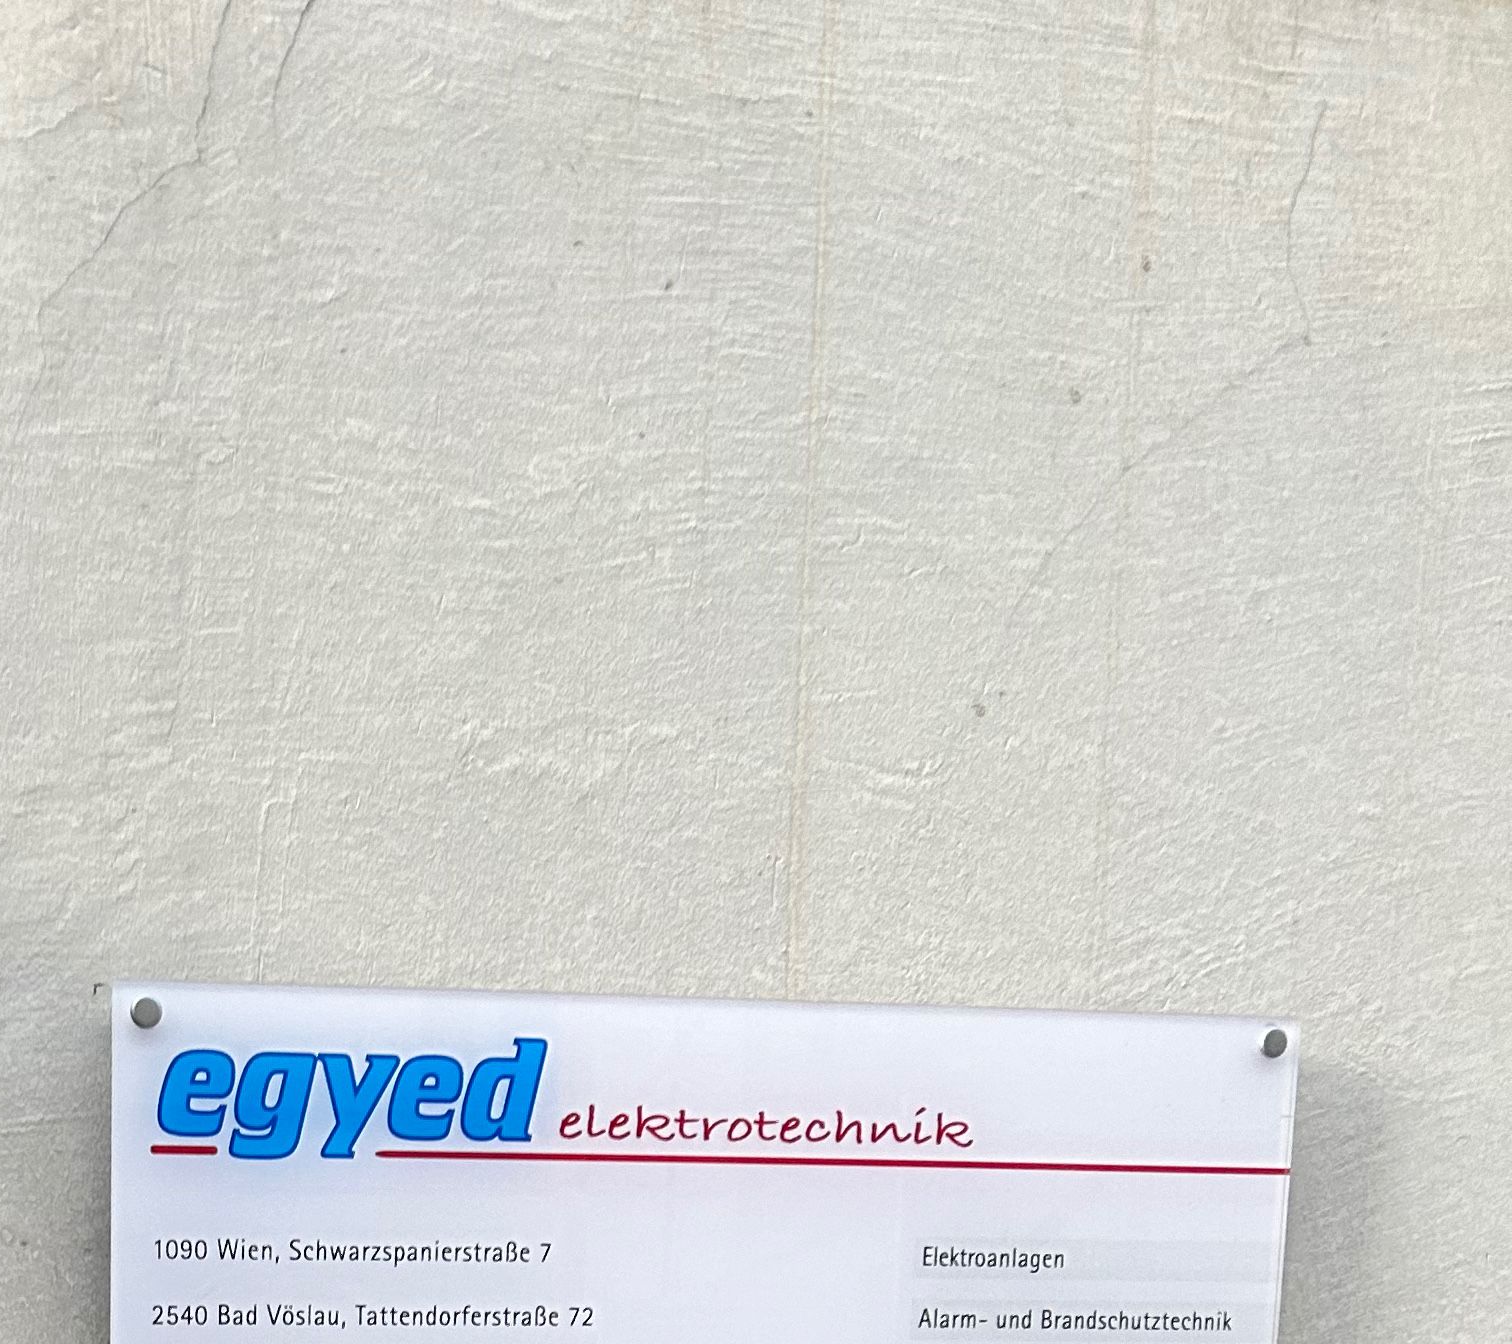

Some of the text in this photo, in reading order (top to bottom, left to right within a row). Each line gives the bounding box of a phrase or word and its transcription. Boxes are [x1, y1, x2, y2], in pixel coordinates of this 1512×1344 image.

[155, 1036, 974, 1160] egyed elektrotechnik
[154, 1238, 552, 1268] 1090 Wien, Schwarzspanierstraße 7
[922, 1246, 1065, 1274] Elektroanlagen
[152, 1304, 594, 1330] 2540 Bad Vöslau, Tattendorferstraße 72
[917, 1308, 1232, 1332] Alarm- und Brandschutztechnik
